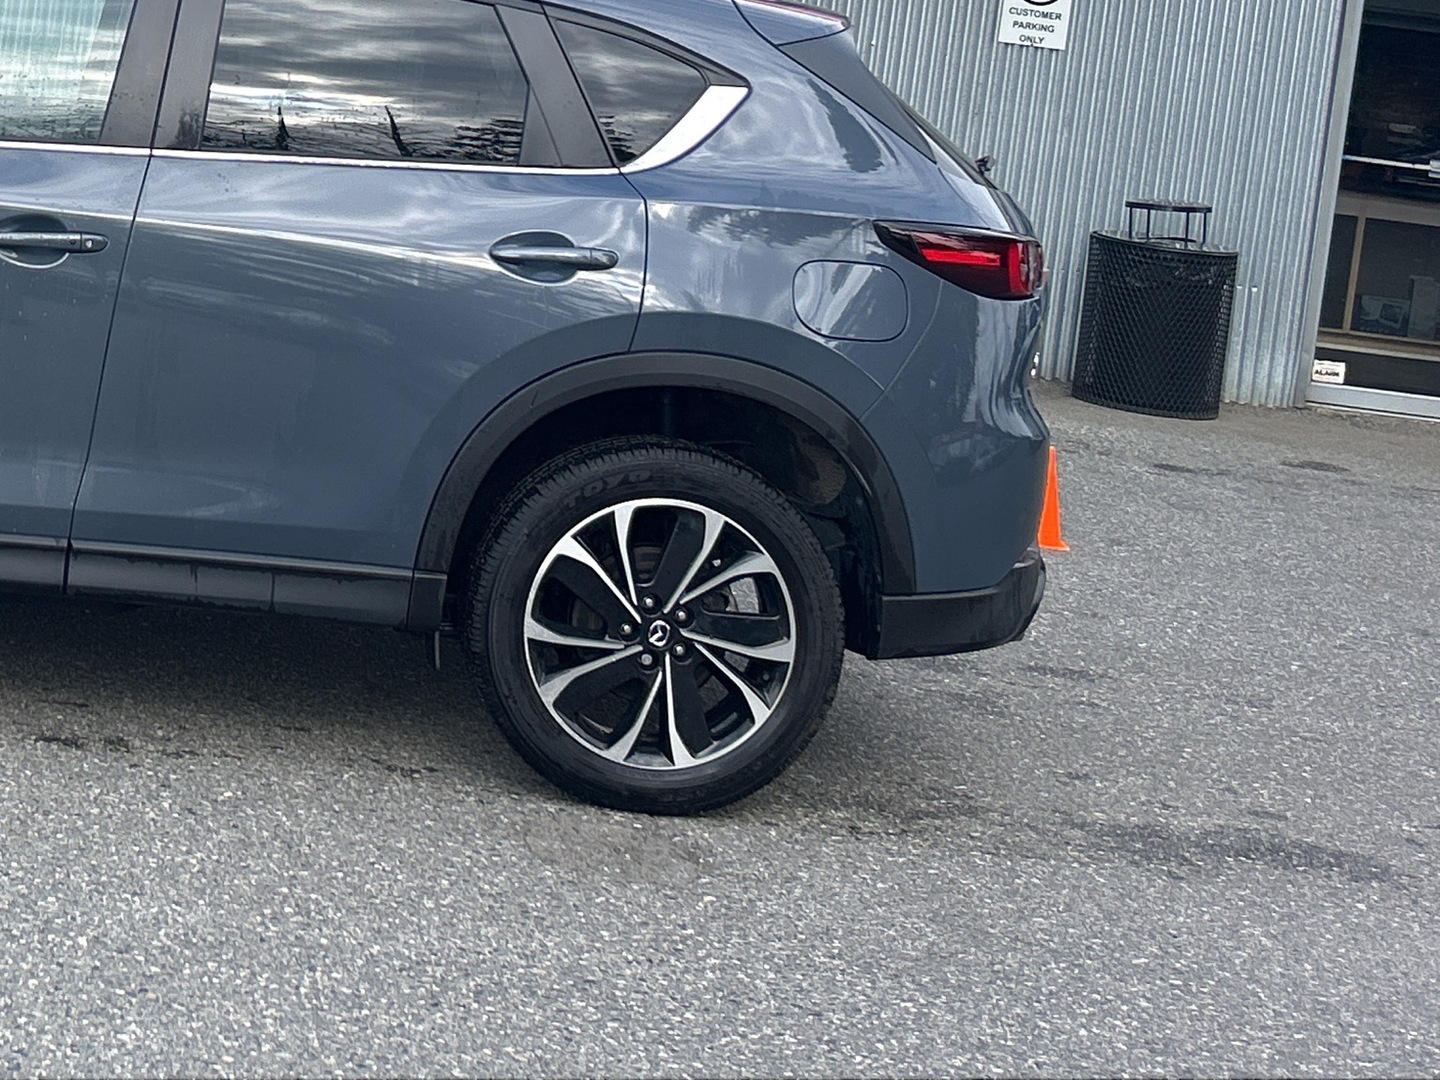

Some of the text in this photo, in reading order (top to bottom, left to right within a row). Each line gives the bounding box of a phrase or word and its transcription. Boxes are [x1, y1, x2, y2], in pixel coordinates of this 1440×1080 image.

[1008, 6, 1062, 21] CUSTOMER
[1012, 20, 1055, 33] PARKING
[1018, 34, 1045, 45] ONLY
[563, 469, 652, 508] TOYO
